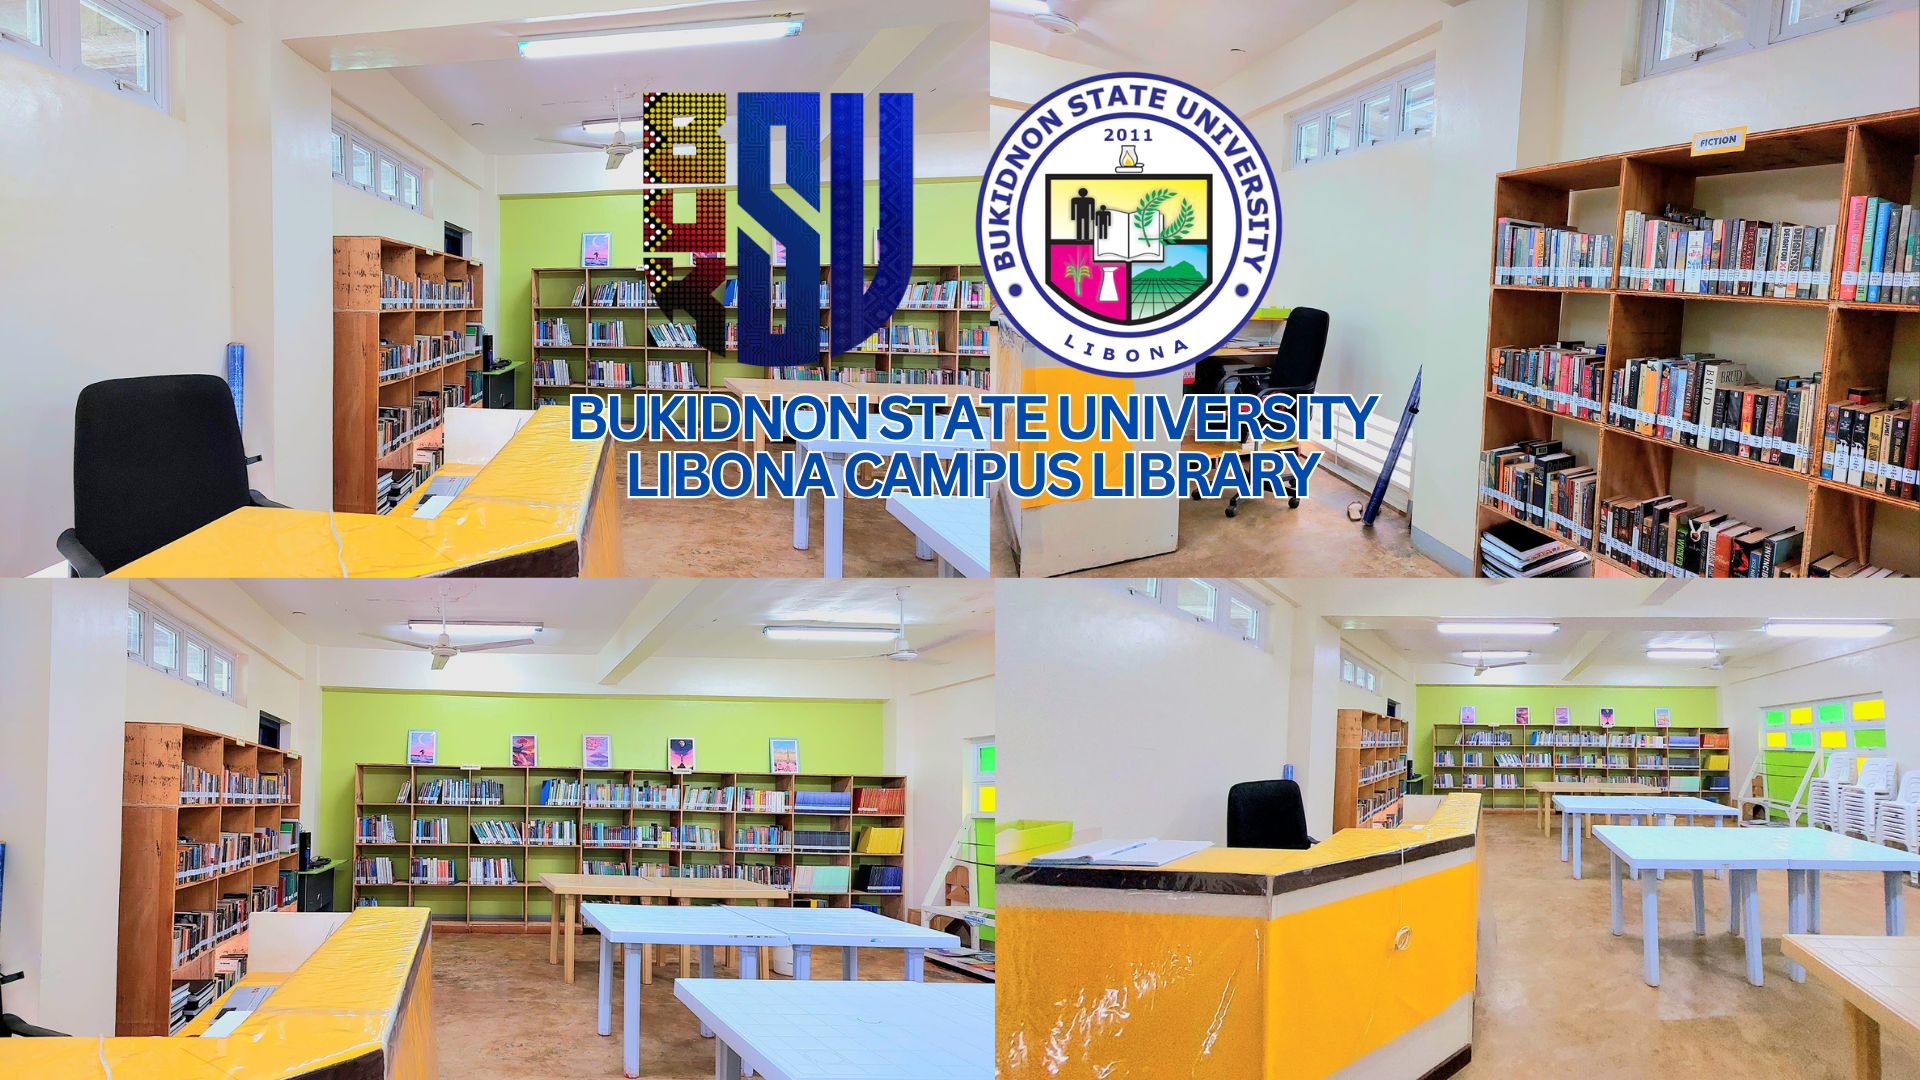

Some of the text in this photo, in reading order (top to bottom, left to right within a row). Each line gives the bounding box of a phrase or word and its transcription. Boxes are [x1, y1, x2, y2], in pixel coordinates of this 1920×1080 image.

[1700, 135, 1737, 147] FICTION
[1780, 228, 1791, 261] DEIGHTON
[1790, 228, 1803, 271] DEIGHTON
[1703, 369, 1714, 406] BRUD
[1720, 370, 1743, 383] BRUD
[1883, 422, 1891, 437] JAMES
[1675, 539, 1686, 567] WICKED
[1761, 546, 1772, 578] INVINCIB
